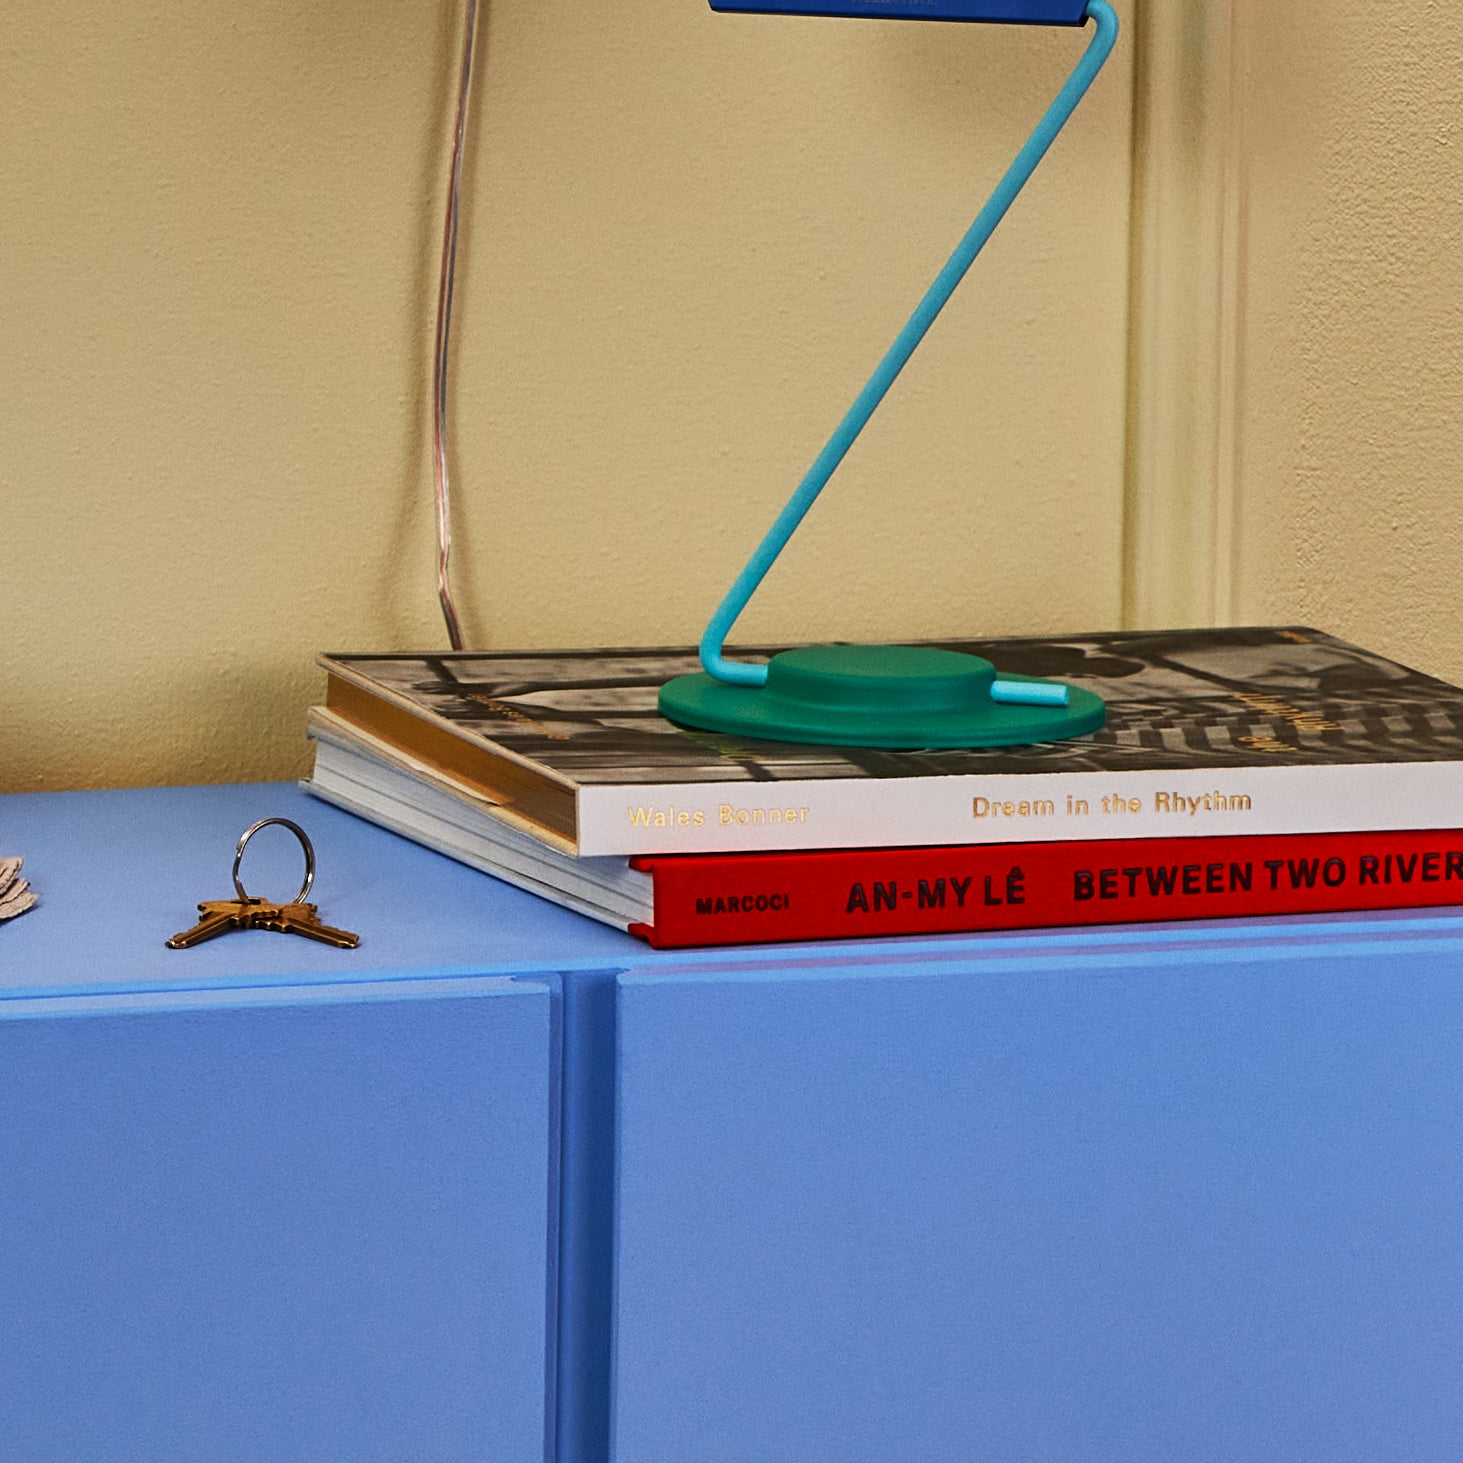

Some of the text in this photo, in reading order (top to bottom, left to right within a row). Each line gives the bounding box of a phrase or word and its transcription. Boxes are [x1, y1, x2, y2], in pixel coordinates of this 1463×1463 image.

[628, 803, 810, 828] Wales Bonner
[972, 790, 1252, 819] Dream in the Rhythm
[695, 894, 790, 915] MARCOCI
[845, 877, 973, 914] AN-MY
[984, 866, 1026, 906] LÊ
[1073, 861, 1254, 902] BETWEEN
[1264, 857, 1347, 890] TWO
